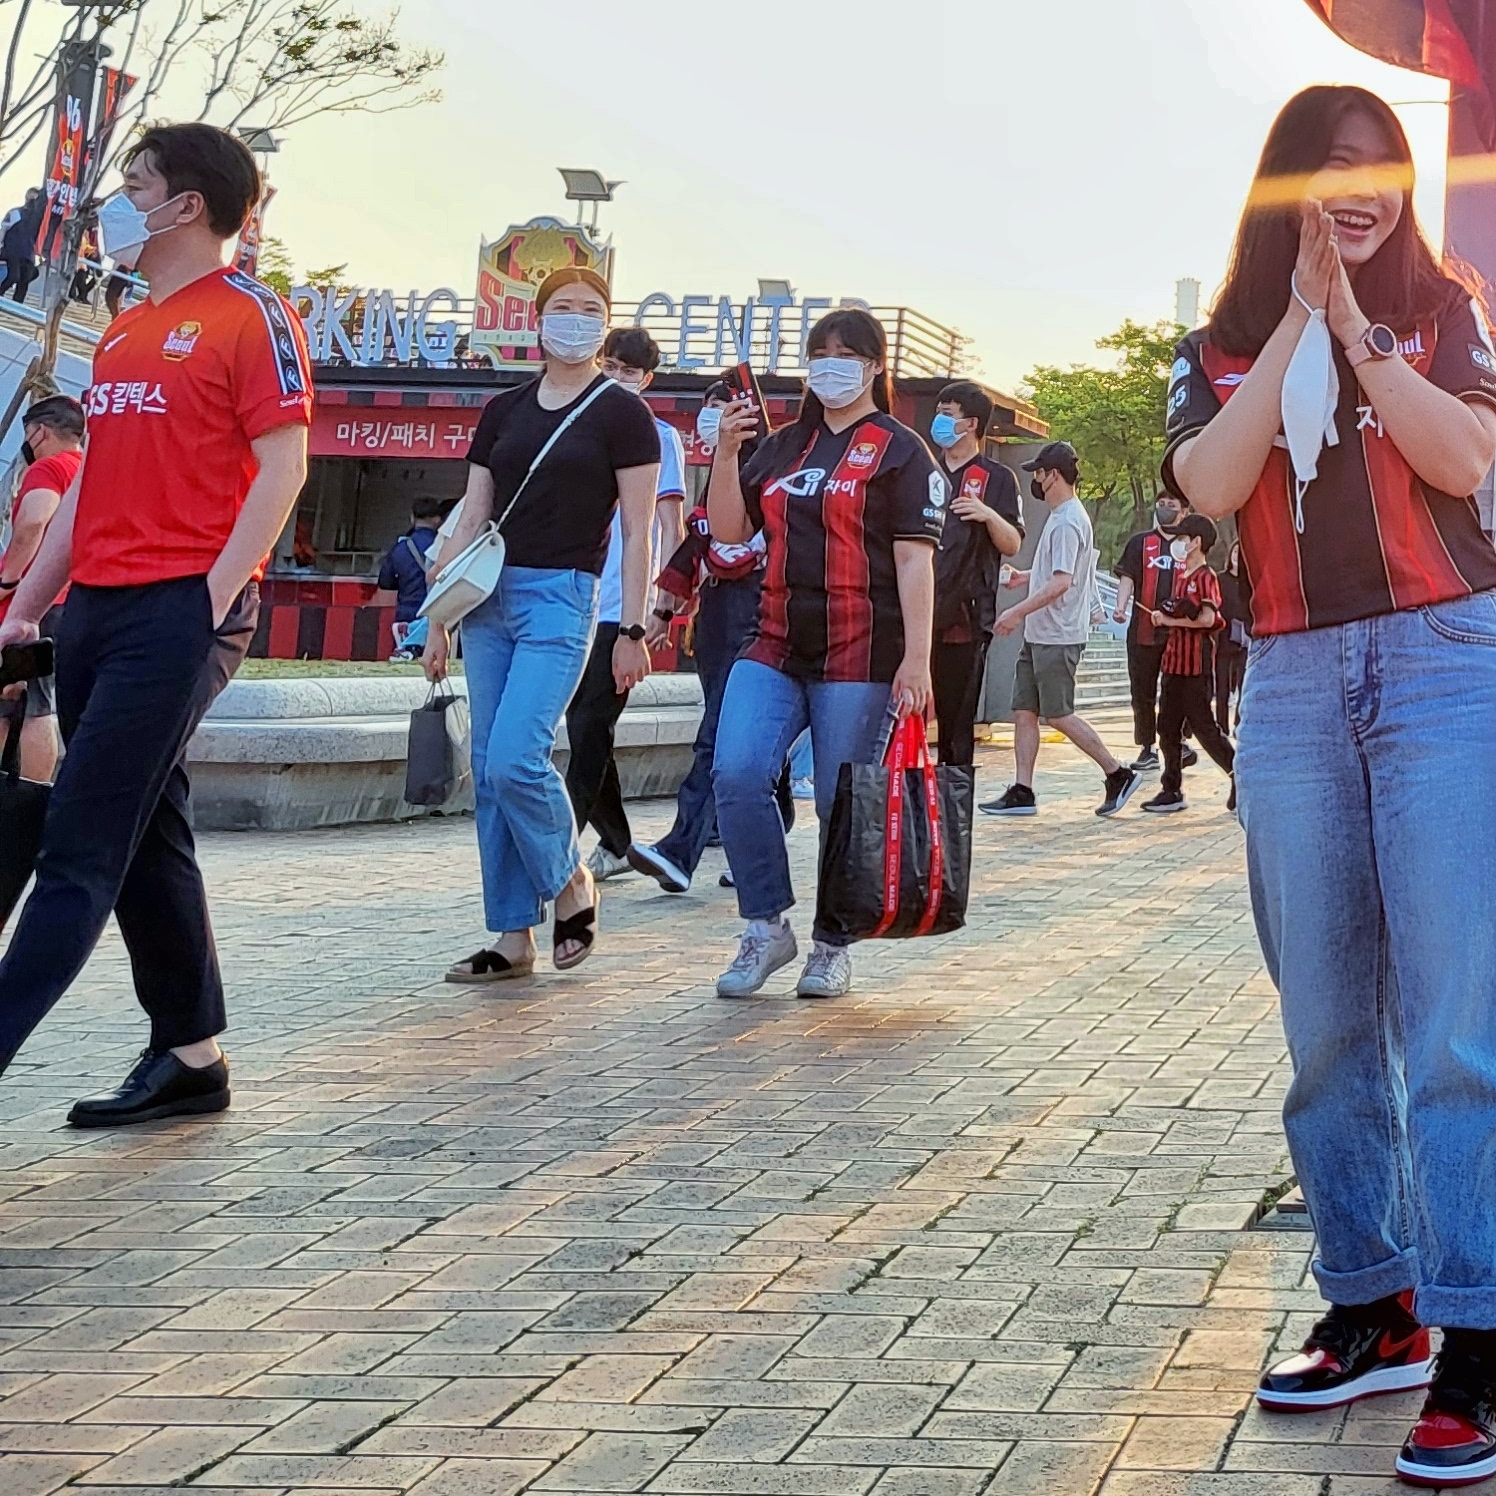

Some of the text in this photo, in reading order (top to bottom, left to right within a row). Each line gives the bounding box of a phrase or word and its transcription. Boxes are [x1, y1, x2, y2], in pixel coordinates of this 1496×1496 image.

[634, 292, 870, 369] CENTE
[336, 421, 435, 450] 마킹/패치
[824, 478, 858, 498] 자이
